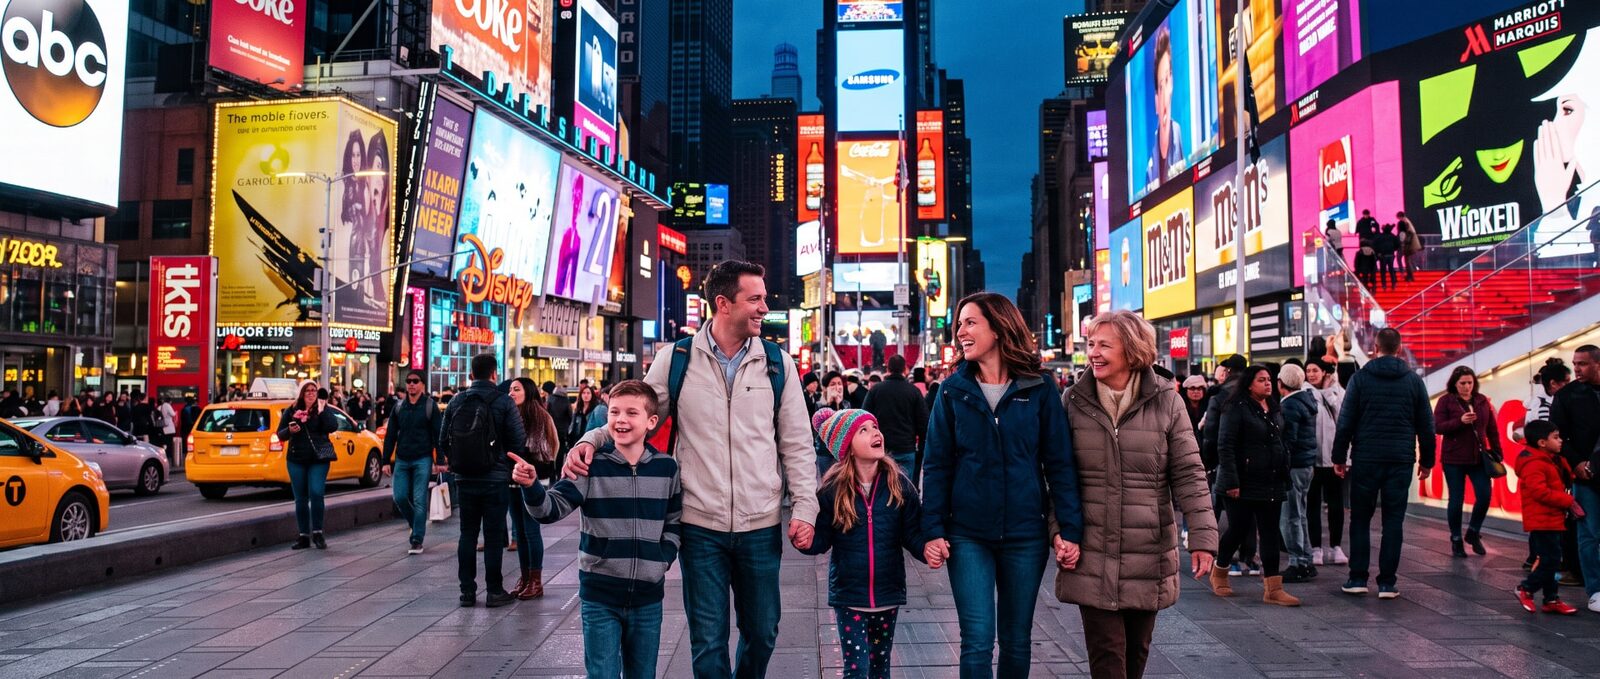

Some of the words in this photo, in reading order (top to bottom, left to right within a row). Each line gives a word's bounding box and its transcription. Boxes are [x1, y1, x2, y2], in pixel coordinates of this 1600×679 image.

[455, 0, 522, 53] oke
[1494, 0, 1565, 31] MARRIOTT
[1496, 16, 1559, 46] MARQUIS
[1, 9, 107, 87] abc
[847, 74, 895, 86] SAMSUNG
[227, 114, 247, 124] The
[251, 112, 285, 122] moble
[1323, 160, 1348, 188] Coke
[417, 204, 453, 238] NEER
[164, 263, 200, 338] tkts
[9, 481, 22, 502] T
